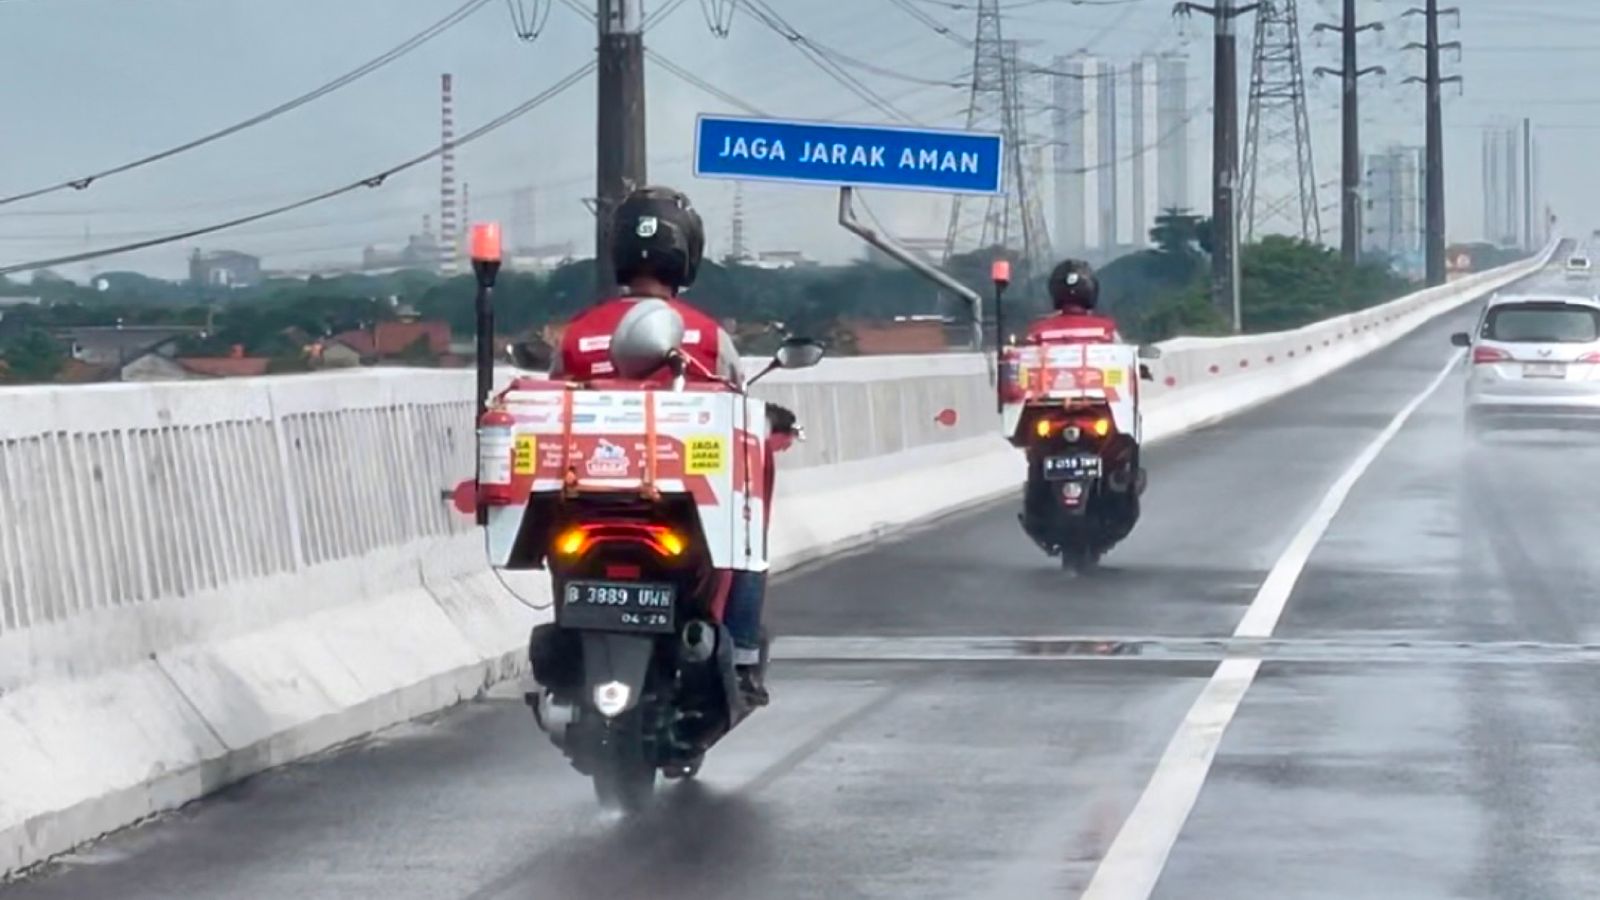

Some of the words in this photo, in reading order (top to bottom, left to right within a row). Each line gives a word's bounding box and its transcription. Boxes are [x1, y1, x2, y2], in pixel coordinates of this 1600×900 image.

[719, 136, 786, 161] JAGA
[798, 142, 885, 167] JARAK
[899, 148, 979, 173] AMAN
[692, 441, 720, 450] JAGA
[568, 587, 579, 603] B
[587, 587, 628, 605] 3889
